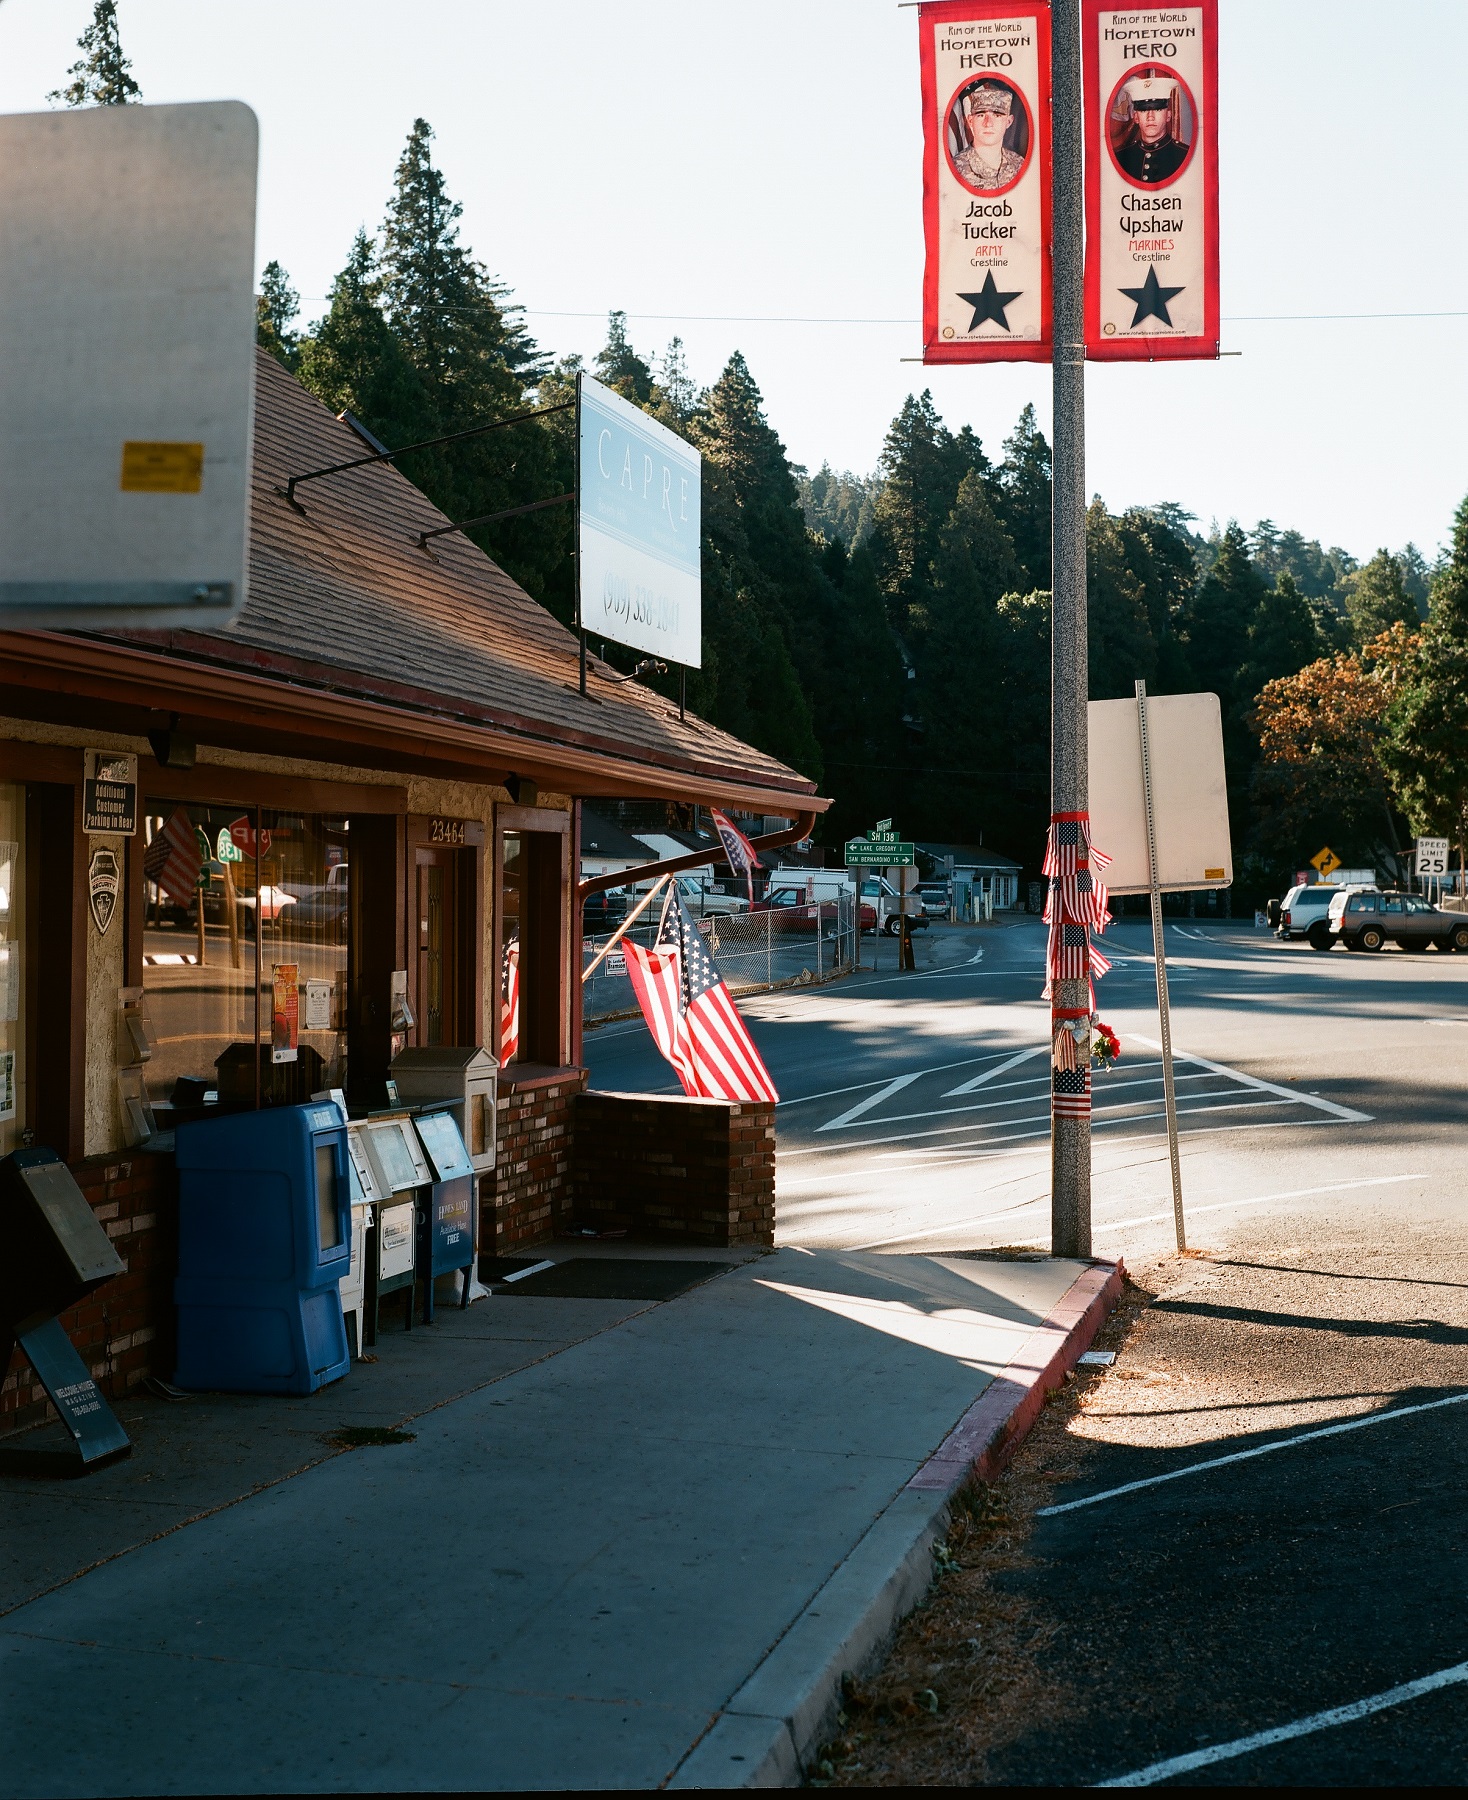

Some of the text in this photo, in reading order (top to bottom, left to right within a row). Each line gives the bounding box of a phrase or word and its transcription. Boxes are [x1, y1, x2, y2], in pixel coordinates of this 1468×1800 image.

[1112, 14, 1126, 24] RIM
[1143, 14, 1157, 23] THE
[1159, 13, 1187, 23] WORLD
[948, 25, 962, 35] RIM
[978, 25, 992, 34] THE
[994, 23, 1022, 33] WORLD
[1105, 28, 1195, 41] HOMETOWN
[941, 37, 1030, 51] HOMETOWN
[1124, 43, 1177, 59] HERO
[960, 53, 1012, 69] HERO
[966, 200, 1012, 218] Jacob
[1121, 195, 1181, 210] Chasen
[962, 223, 1016, 239] Tucker
[1120, 216, 1183, 234] Upshaw
[975, 245, 1003, 256] ARMY
[1129, 239, 1174, 251] MARINES
[971, 258, 1008, 267] Crestline
[1133, 252, 1170, 262] Crestline
[598, 429, 688, 532] CAPRE
[604, 570, 630, 624] (909)
[96, 784, 126, 799] Additional
[97, 799, 124, 813] Customer
[87, 813, 133, 829] Parking in Rear
[432, 820, 464, 843] 23464
[872, 832, 894, 842] SH 138
[1420, 859, 1444, 873] 25
[93, 882, 115, 890] SECURITY
[447, 1232, 460, 1245] FREE
[65, 1391, 96, 1405] MAGAZINE
